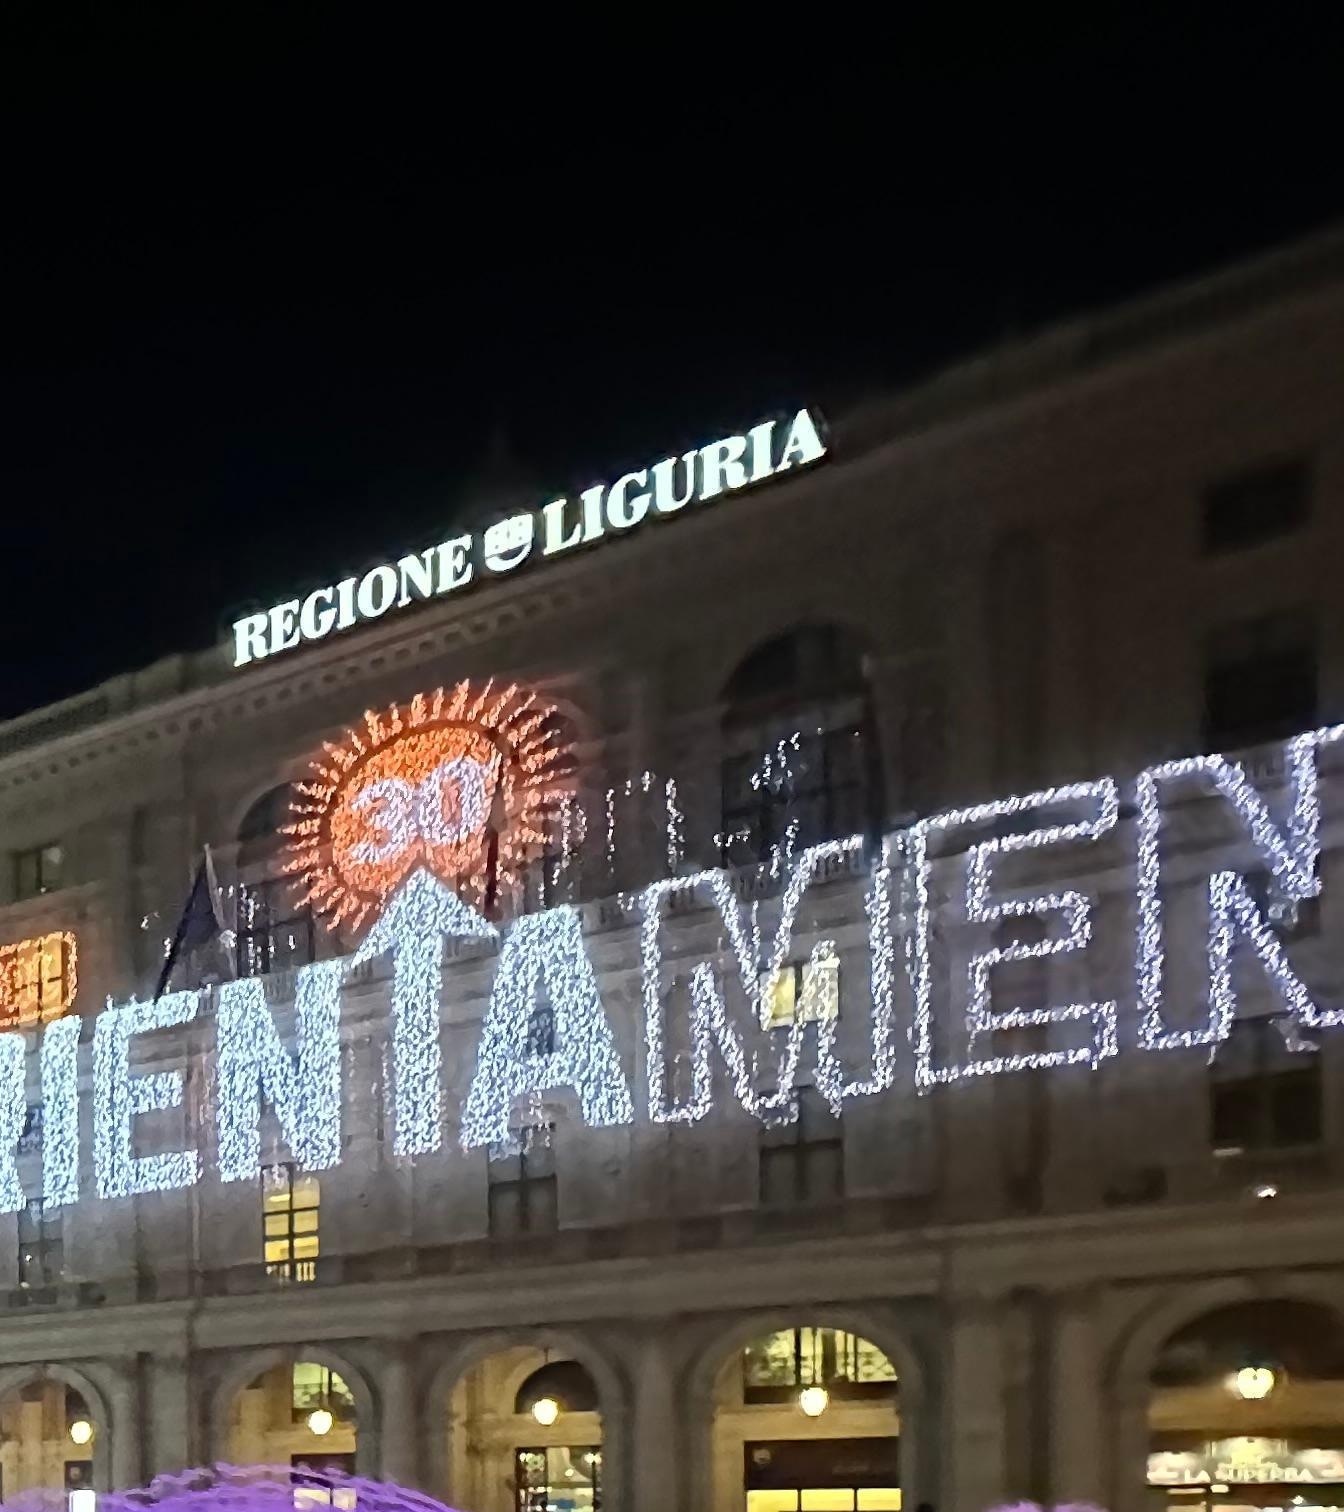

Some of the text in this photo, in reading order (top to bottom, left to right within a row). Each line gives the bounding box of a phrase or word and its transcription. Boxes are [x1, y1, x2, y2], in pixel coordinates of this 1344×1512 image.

[232, 408, 827, 667] REGIONE LIGURIA
[349, 756, 493, 865] 30
[1184, 1468, 1211, 1482] LA
